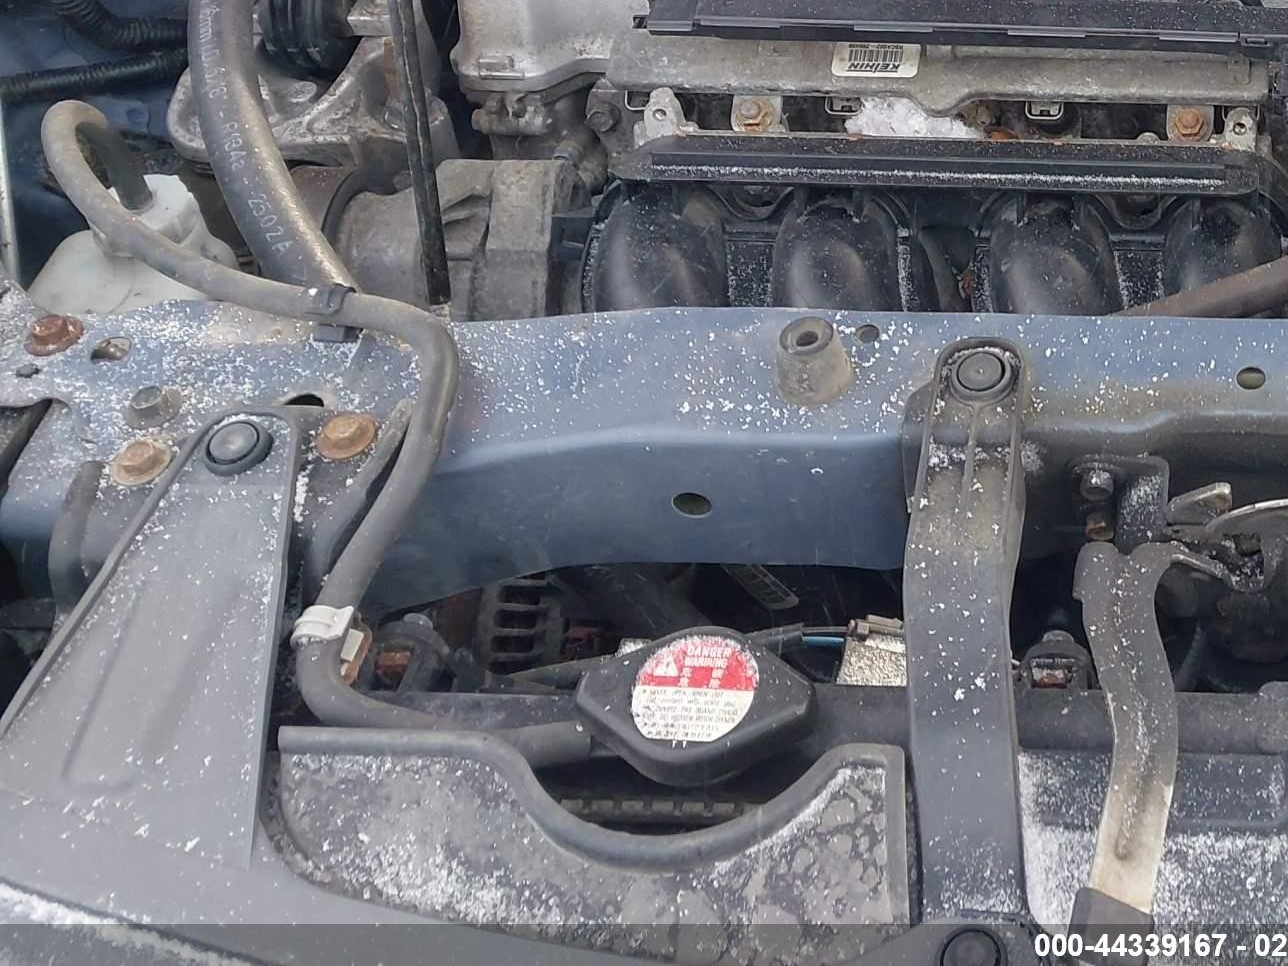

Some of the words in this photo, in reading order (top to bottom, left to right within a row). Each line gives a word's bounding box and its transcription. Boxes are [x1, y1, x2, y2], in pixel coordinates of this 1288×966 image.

[848, 62, 901, 74] KEIHIN
[686, 646, 732, 658] DANGER
[684, 657, 729, 668] WARNUNG
